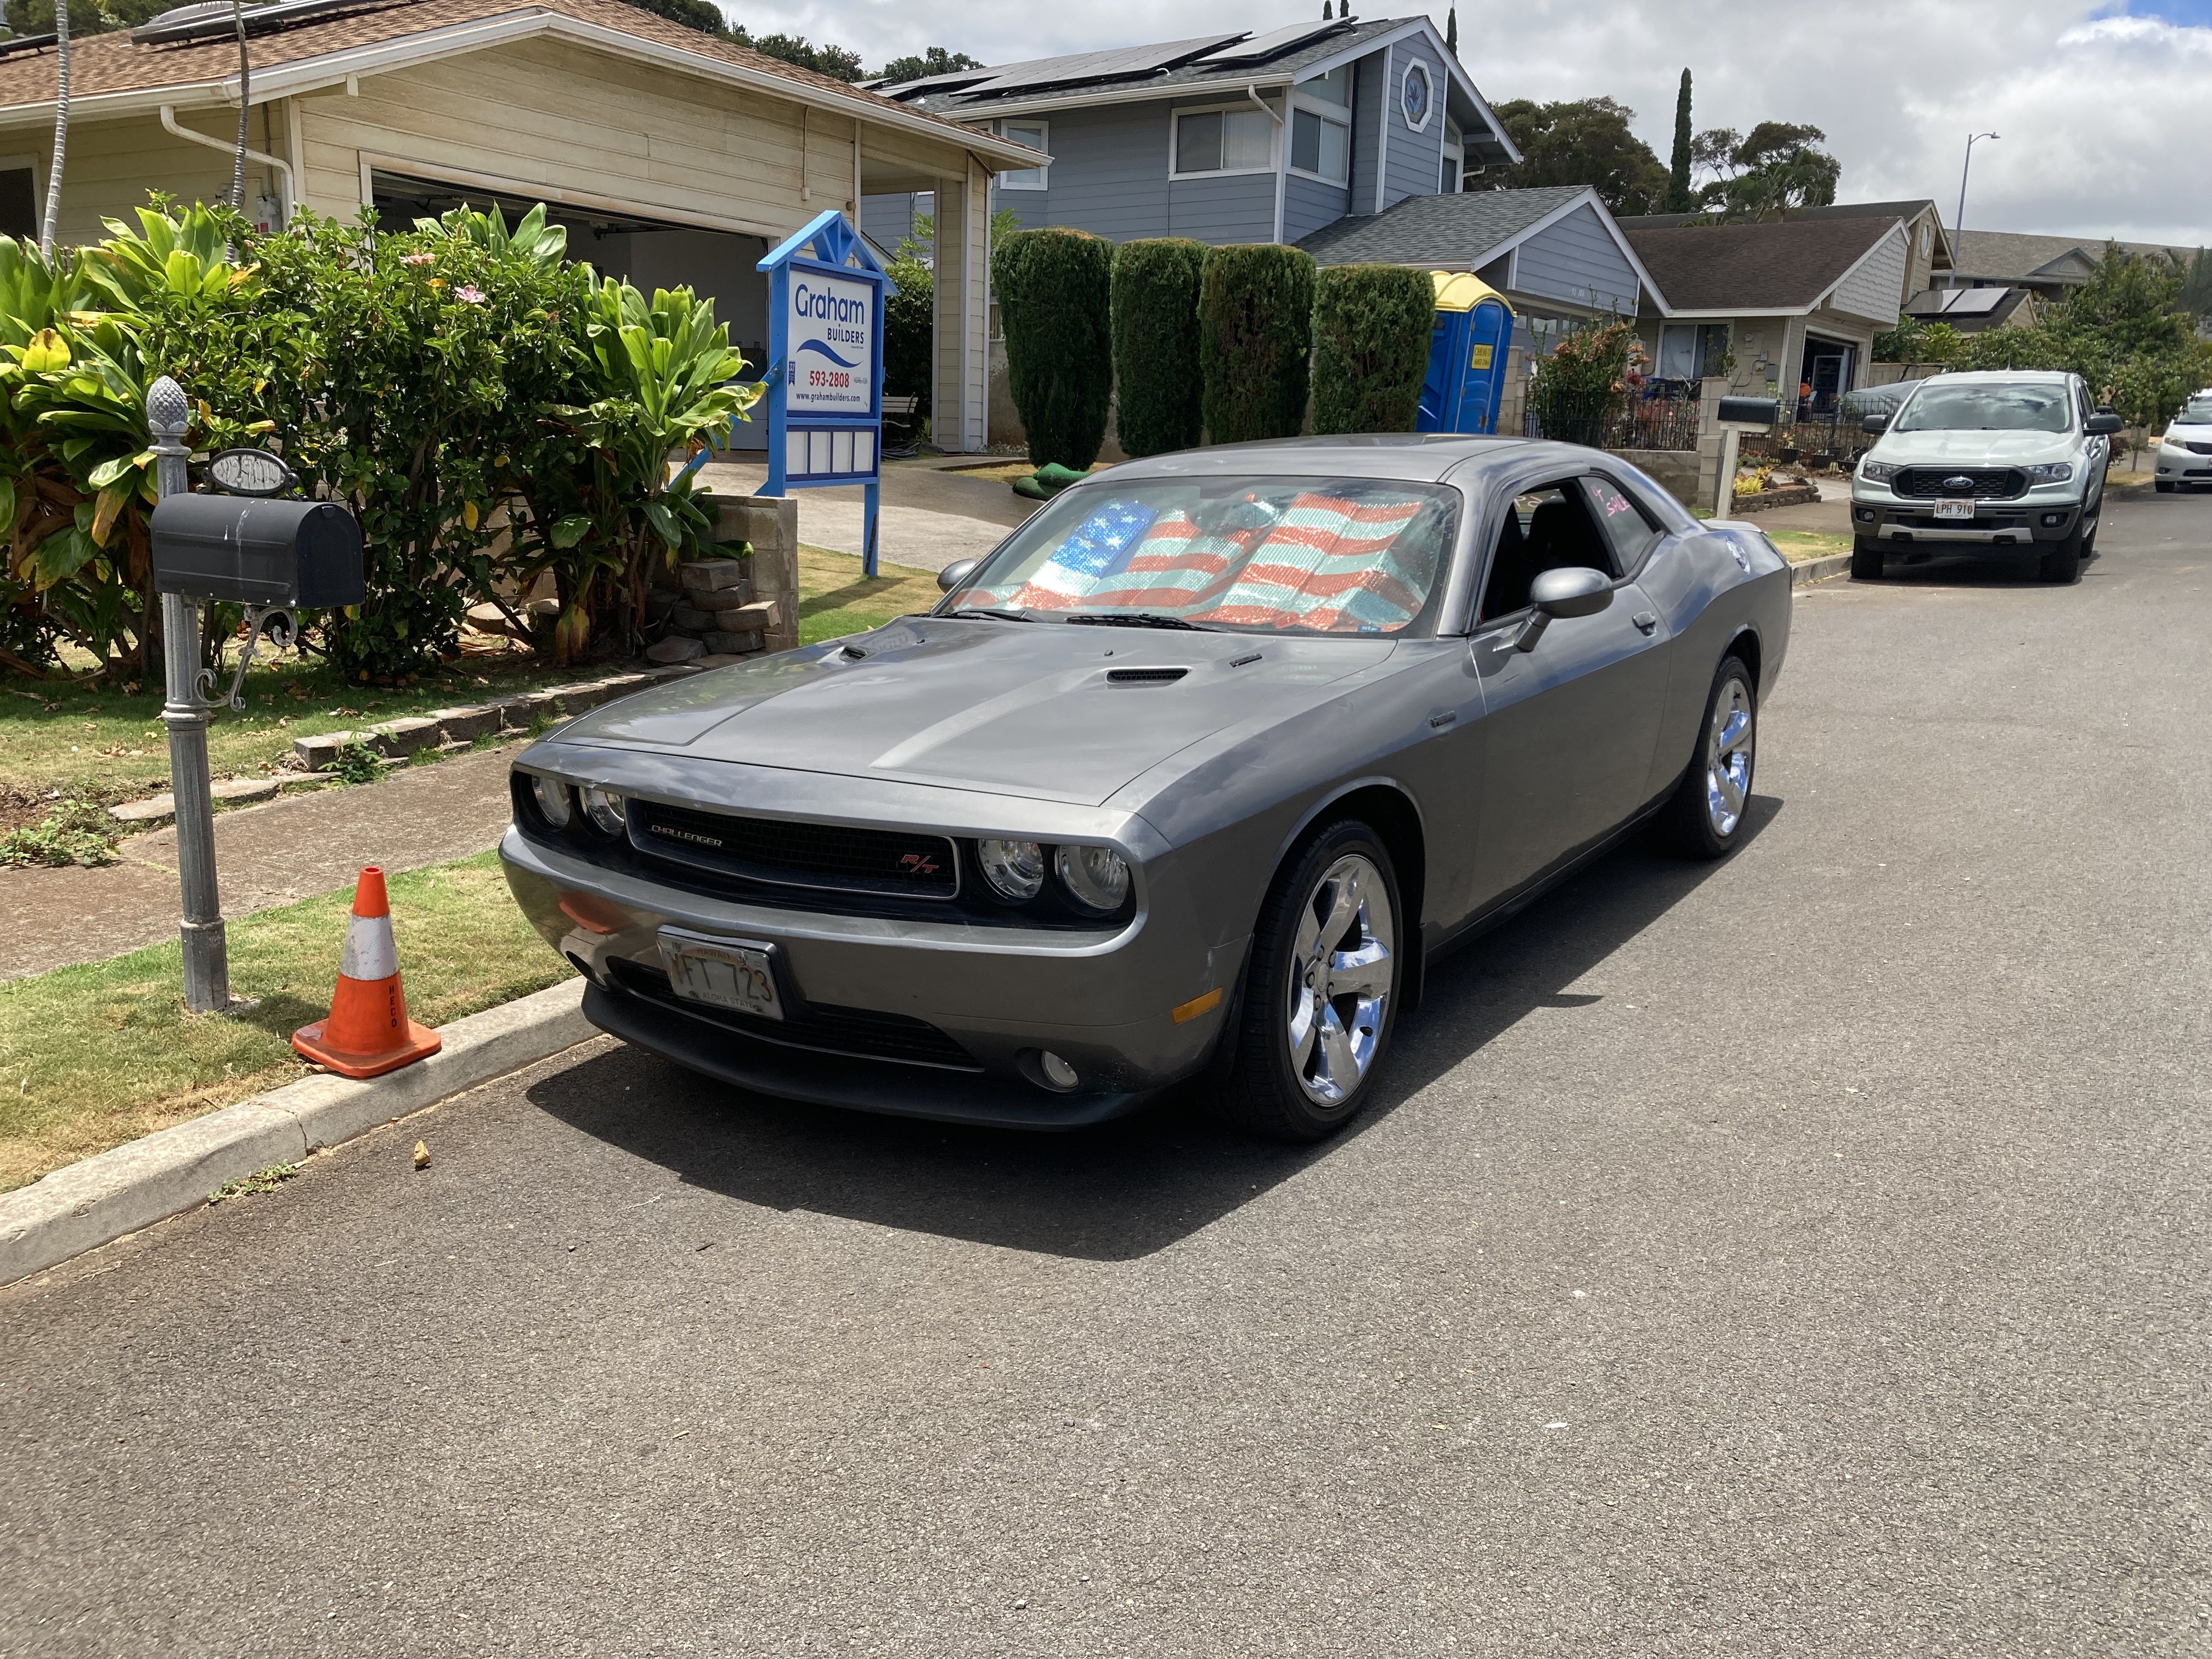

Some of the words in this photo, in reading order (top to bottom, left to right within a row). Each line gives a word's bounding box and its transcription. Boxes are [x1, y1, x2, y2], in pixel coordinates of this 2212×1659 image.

[795, 284, 864, 325] Graham
[810, 370, 849, 388] 593-2808
[796, 392, 860, 403] www.grahambuilders.com
[1936, 504, 1952, 514] LPH
[1957, 504, 1973, 515] 910
[652, 825, 722, 847] CHALLENGER
[901, 854, 939, 873] R/T
[723, 962, 772, 1003] 723
[702, 991, 728, 1003] ALOHA
